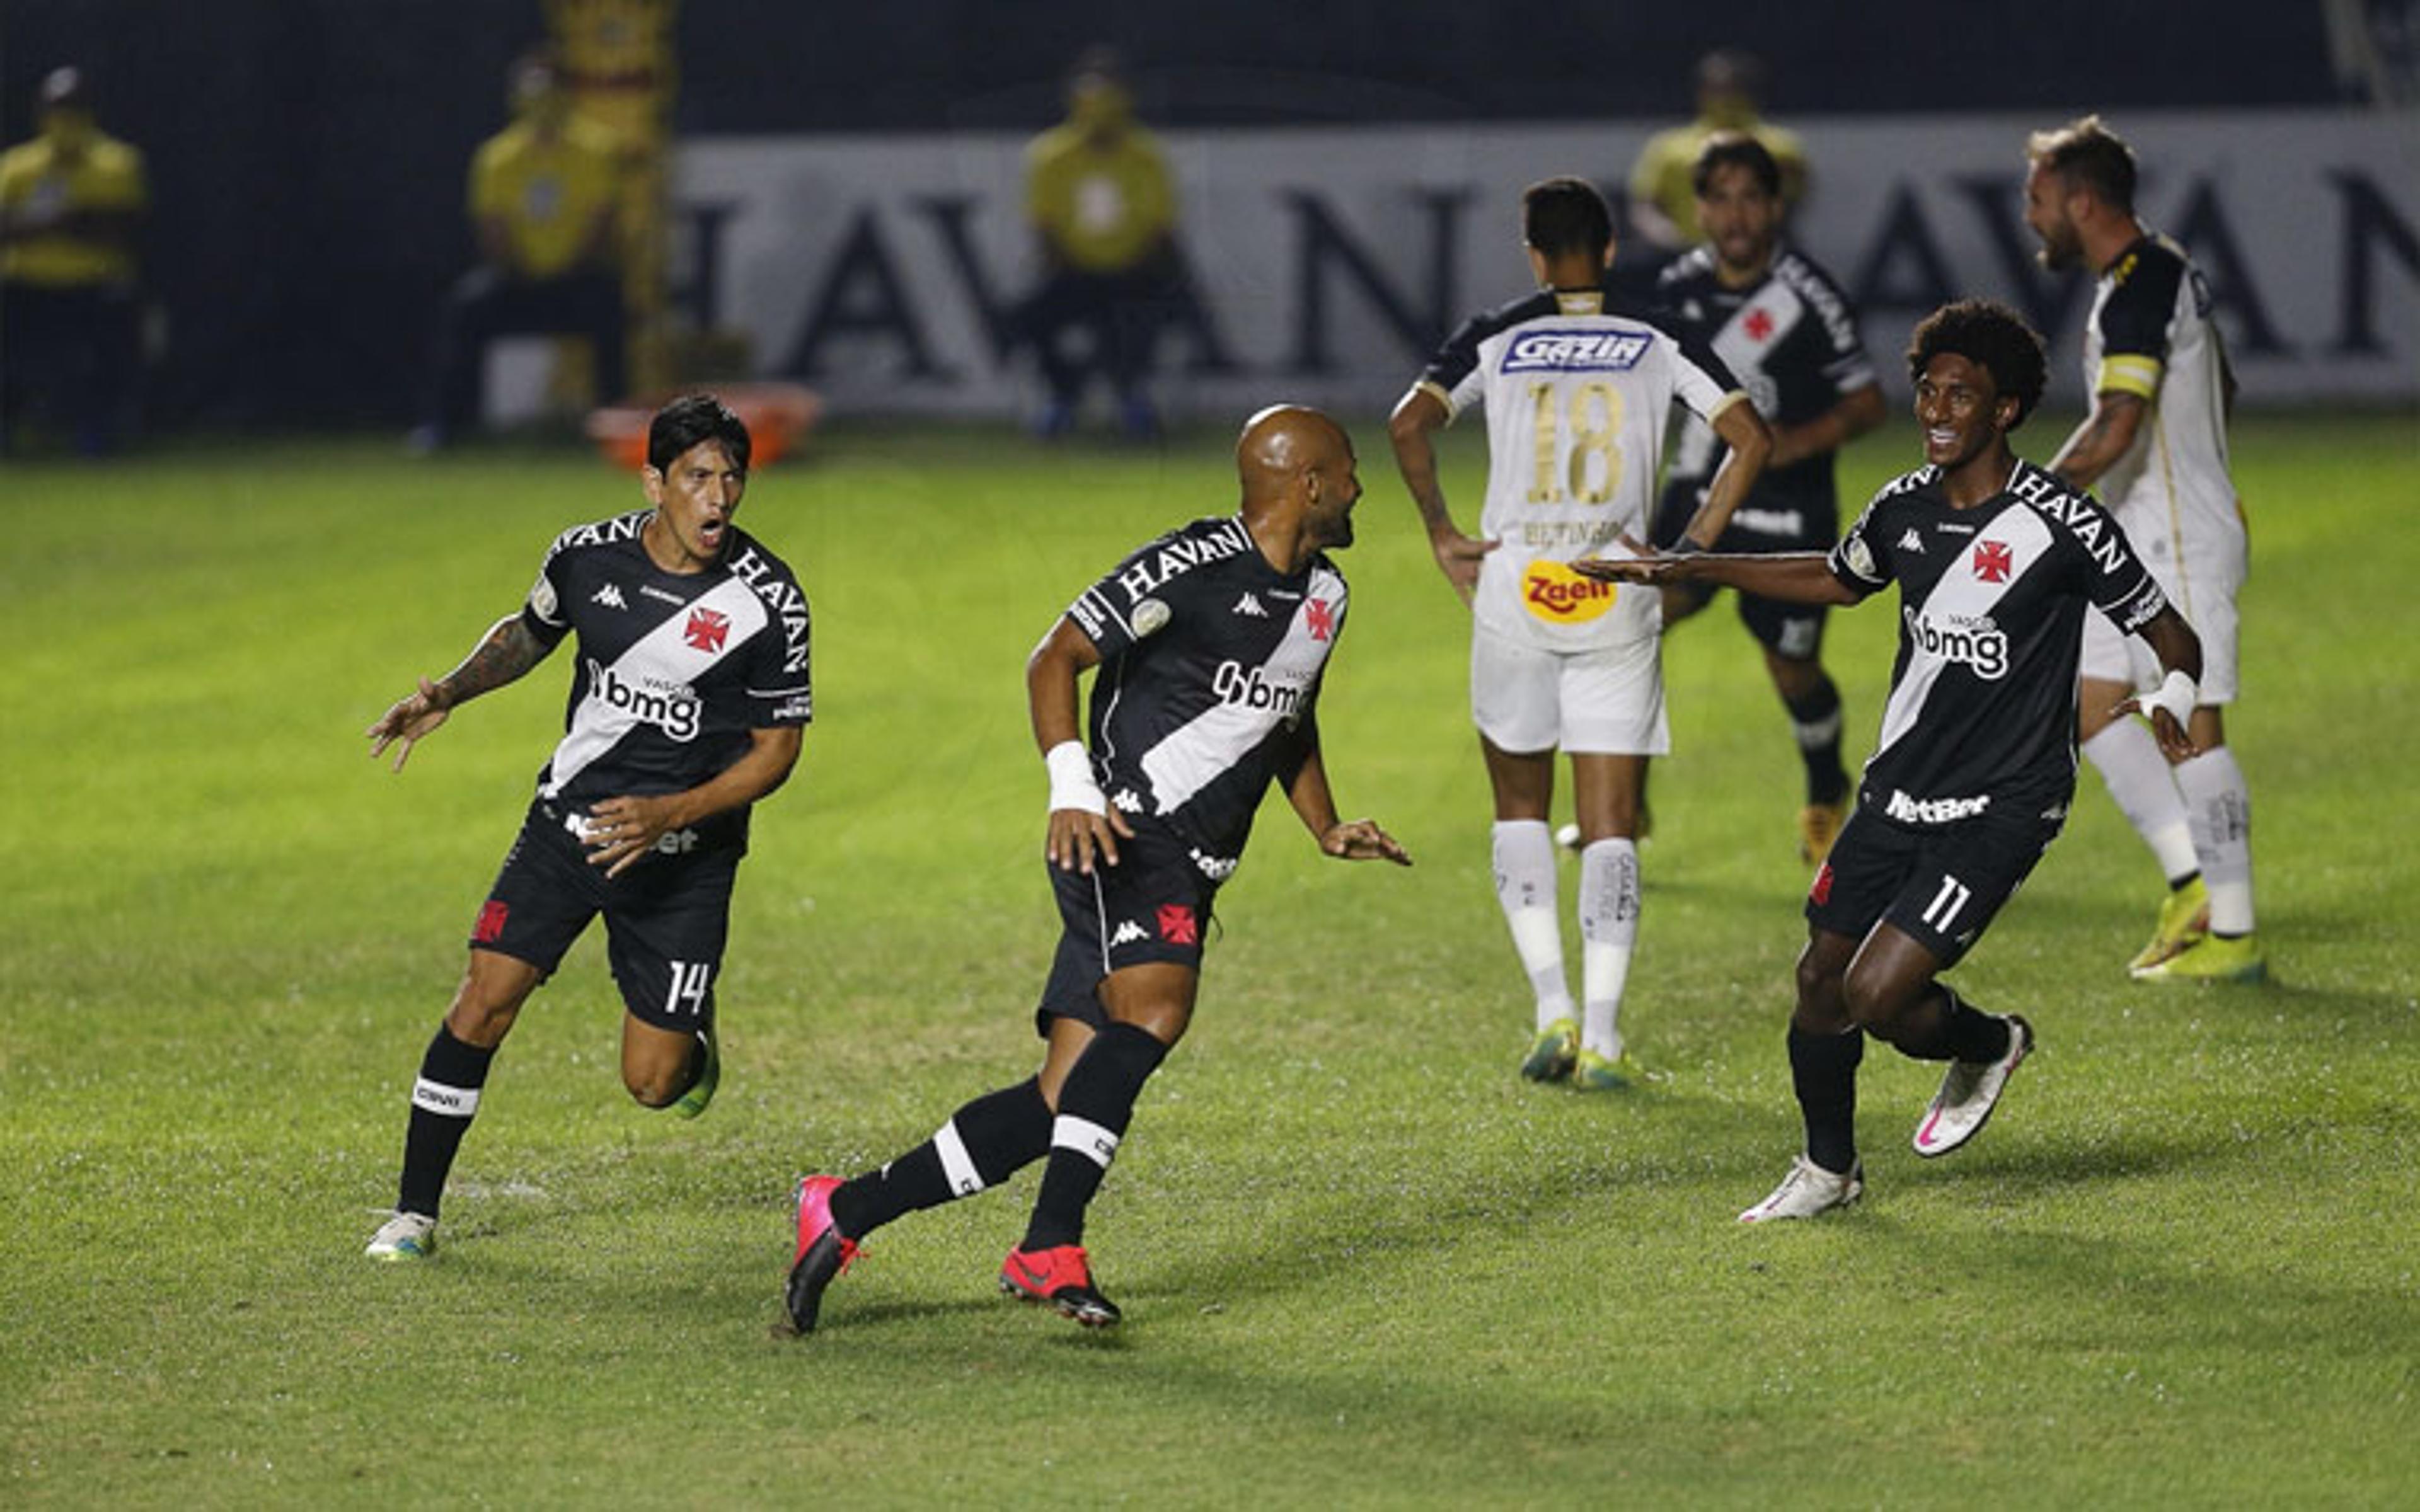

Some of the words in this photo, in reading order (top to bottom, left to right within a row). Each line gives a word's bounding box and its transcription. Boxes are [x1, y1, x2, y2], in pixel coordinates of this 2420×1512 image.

[1526, 381, 1626, 504] 18
[2013, 472, 2128, 575] HAVAN
[1117, 524, 1245, 605] HAVAN
[728, 547, 808, 673] HAVAN
[1922, 616, 2005, 677] bmg
[606, 670, 698, 738] bmg
[1922, 874, 1971, 934] 11
[665, 961, 710, 1015] 14
